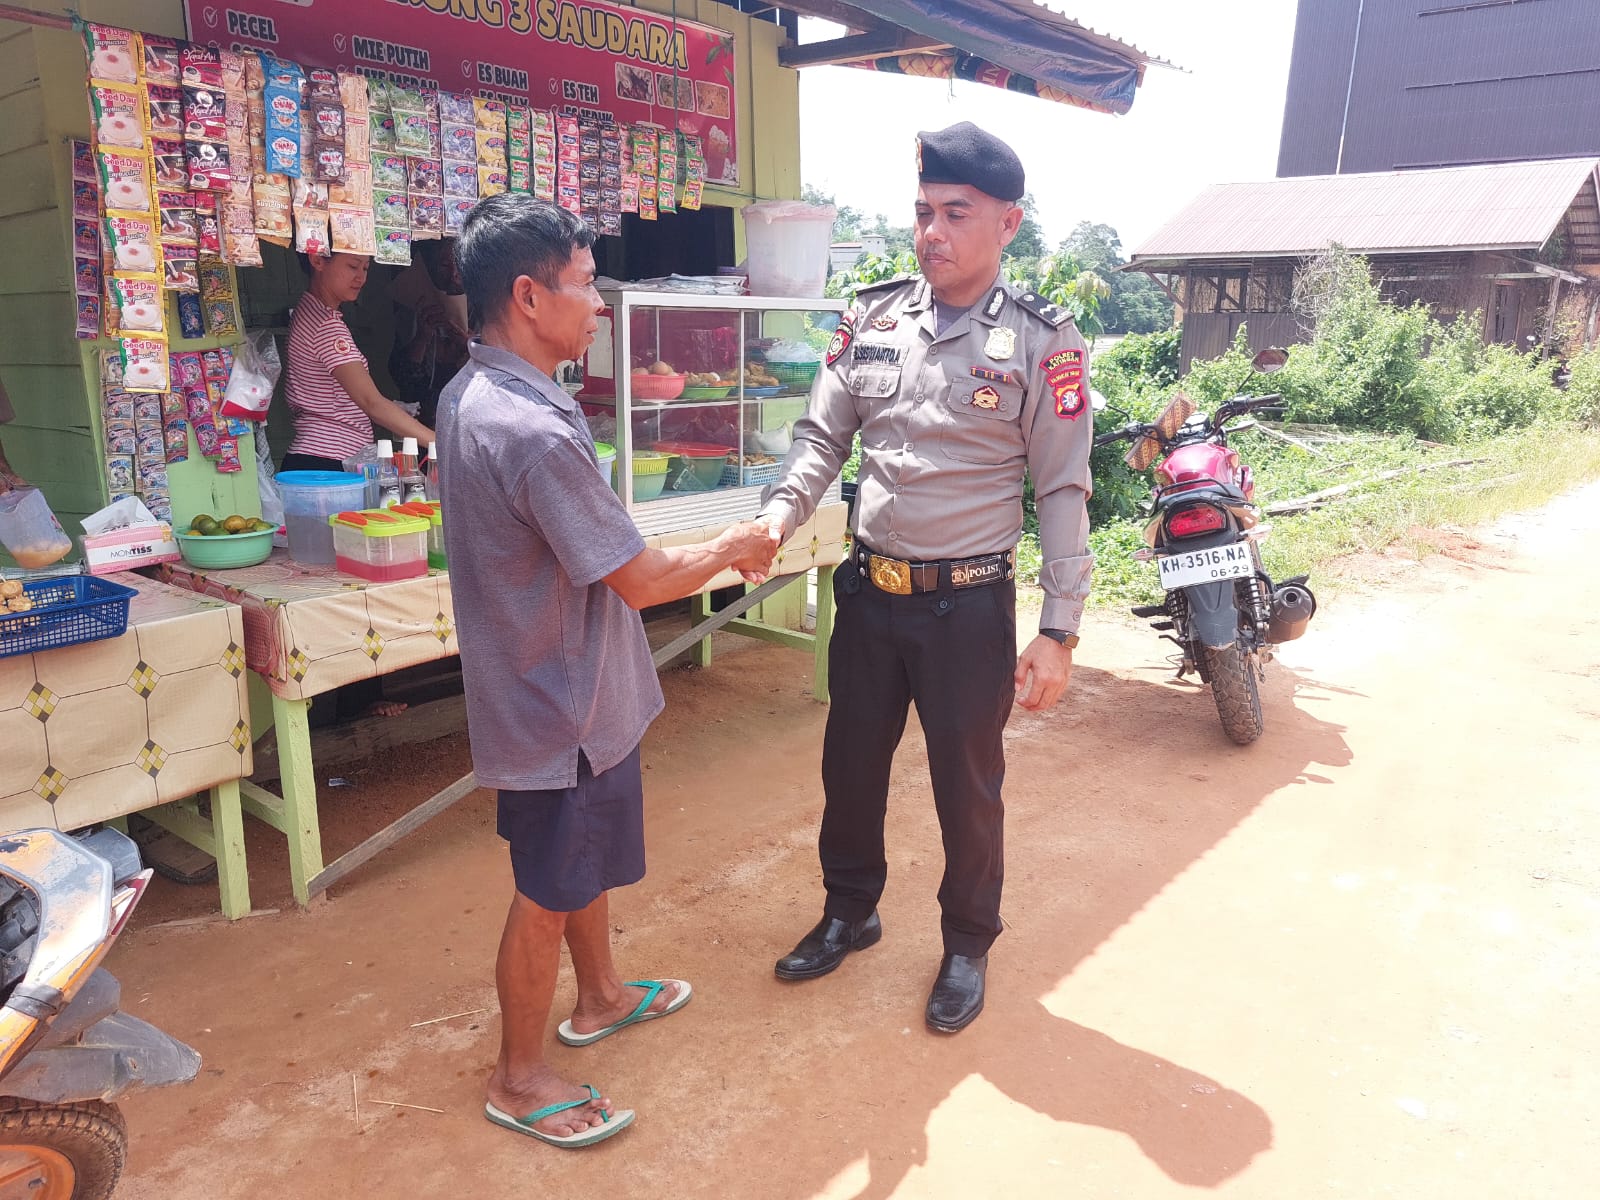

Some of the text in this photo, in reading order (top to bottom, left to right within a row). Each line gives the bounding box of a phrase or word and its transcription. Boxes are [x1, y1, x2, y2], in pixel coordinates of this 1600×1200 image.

[226, 10, 278, 42] PECEL
[508, 0, 531, 33] 3
[536, 0, 688, 70] SAUDARA
[353, 36, 429, 71] MIE PUTIH
[477, 63, 529, 90] ES BUAH
[96, 90, 137, 106] Good Day
[563, 80, 598, 104] ES TEH
[103, 155, 143, 169] Good Day
[161, 193, 194, 207] ABC
[110, 220, 150, 232] Good Day
[117, 281, 157, 292] Good Day
[122, 340, 162, 351] Good Day
[1049, 351, 1075, 364] POLRES
[110, 546, 153, 559] MONTISS
[1162, 546, 1247, 574] KH 3516 NA
[968, 564, 1000, 579] POLISI
